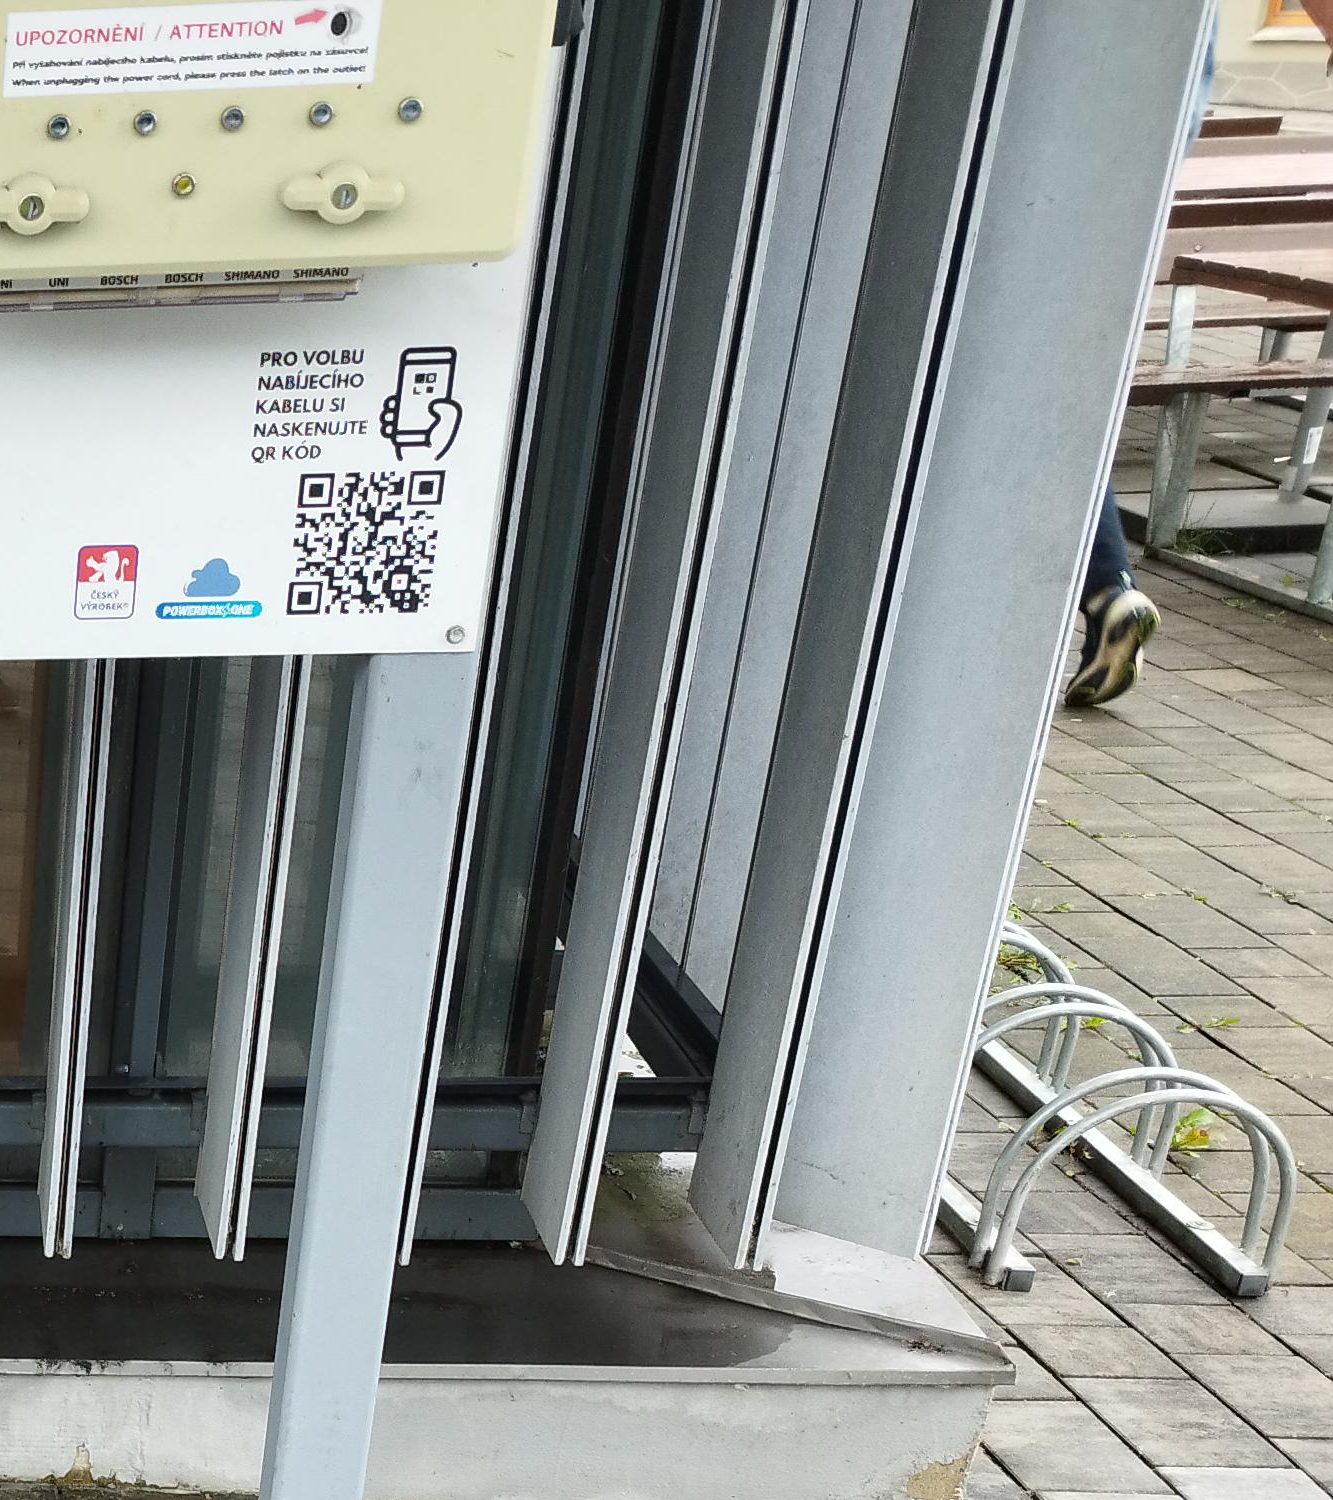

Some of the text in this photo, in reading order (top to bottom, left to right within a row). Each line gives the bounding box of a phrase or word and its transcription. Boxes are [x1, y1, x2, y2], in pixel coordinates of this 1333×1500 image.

[15, 19, 285, 46] UPOZORNĚNÍ ATTENTION
[140, 55, 176, 64] kabelu,
[179, 54, 213, 63] prosím
[12, 77, 40, 87] When
[44, 76, 100, 86] unplugging
[104, 74, 119, 83] the
[122, 74, 154, 84] power
[157, 72, 181, 81] cord,
[184, 72, 216, 81] please
[219, 70, 246, 80] press
[250, 69, 266, 77] the
[269, 67, 294, 76] latch
[297, 67, 310, 75] on
[313, 65, 329, 74] the
[49, 277, 70, 287] UNI
[100, 275, 139, 285] BOSCH
[164, 272, 204, 284] BOSCH
[224, 270, 280, 281] SHIMANO
[293, 267, 349, 278] SHIMANO
[260, 349, 365, 367] PRO VOLBU
[257, 368, 365, 391] NABÍJECÍHO
[255, 397, 346, 414] KABELU SI
[253, 420, 368, 438] NASKENUJTE
[251, 440, 322, 464] QR KÓD
[90, 589, 120, 600] ČESKÝ
